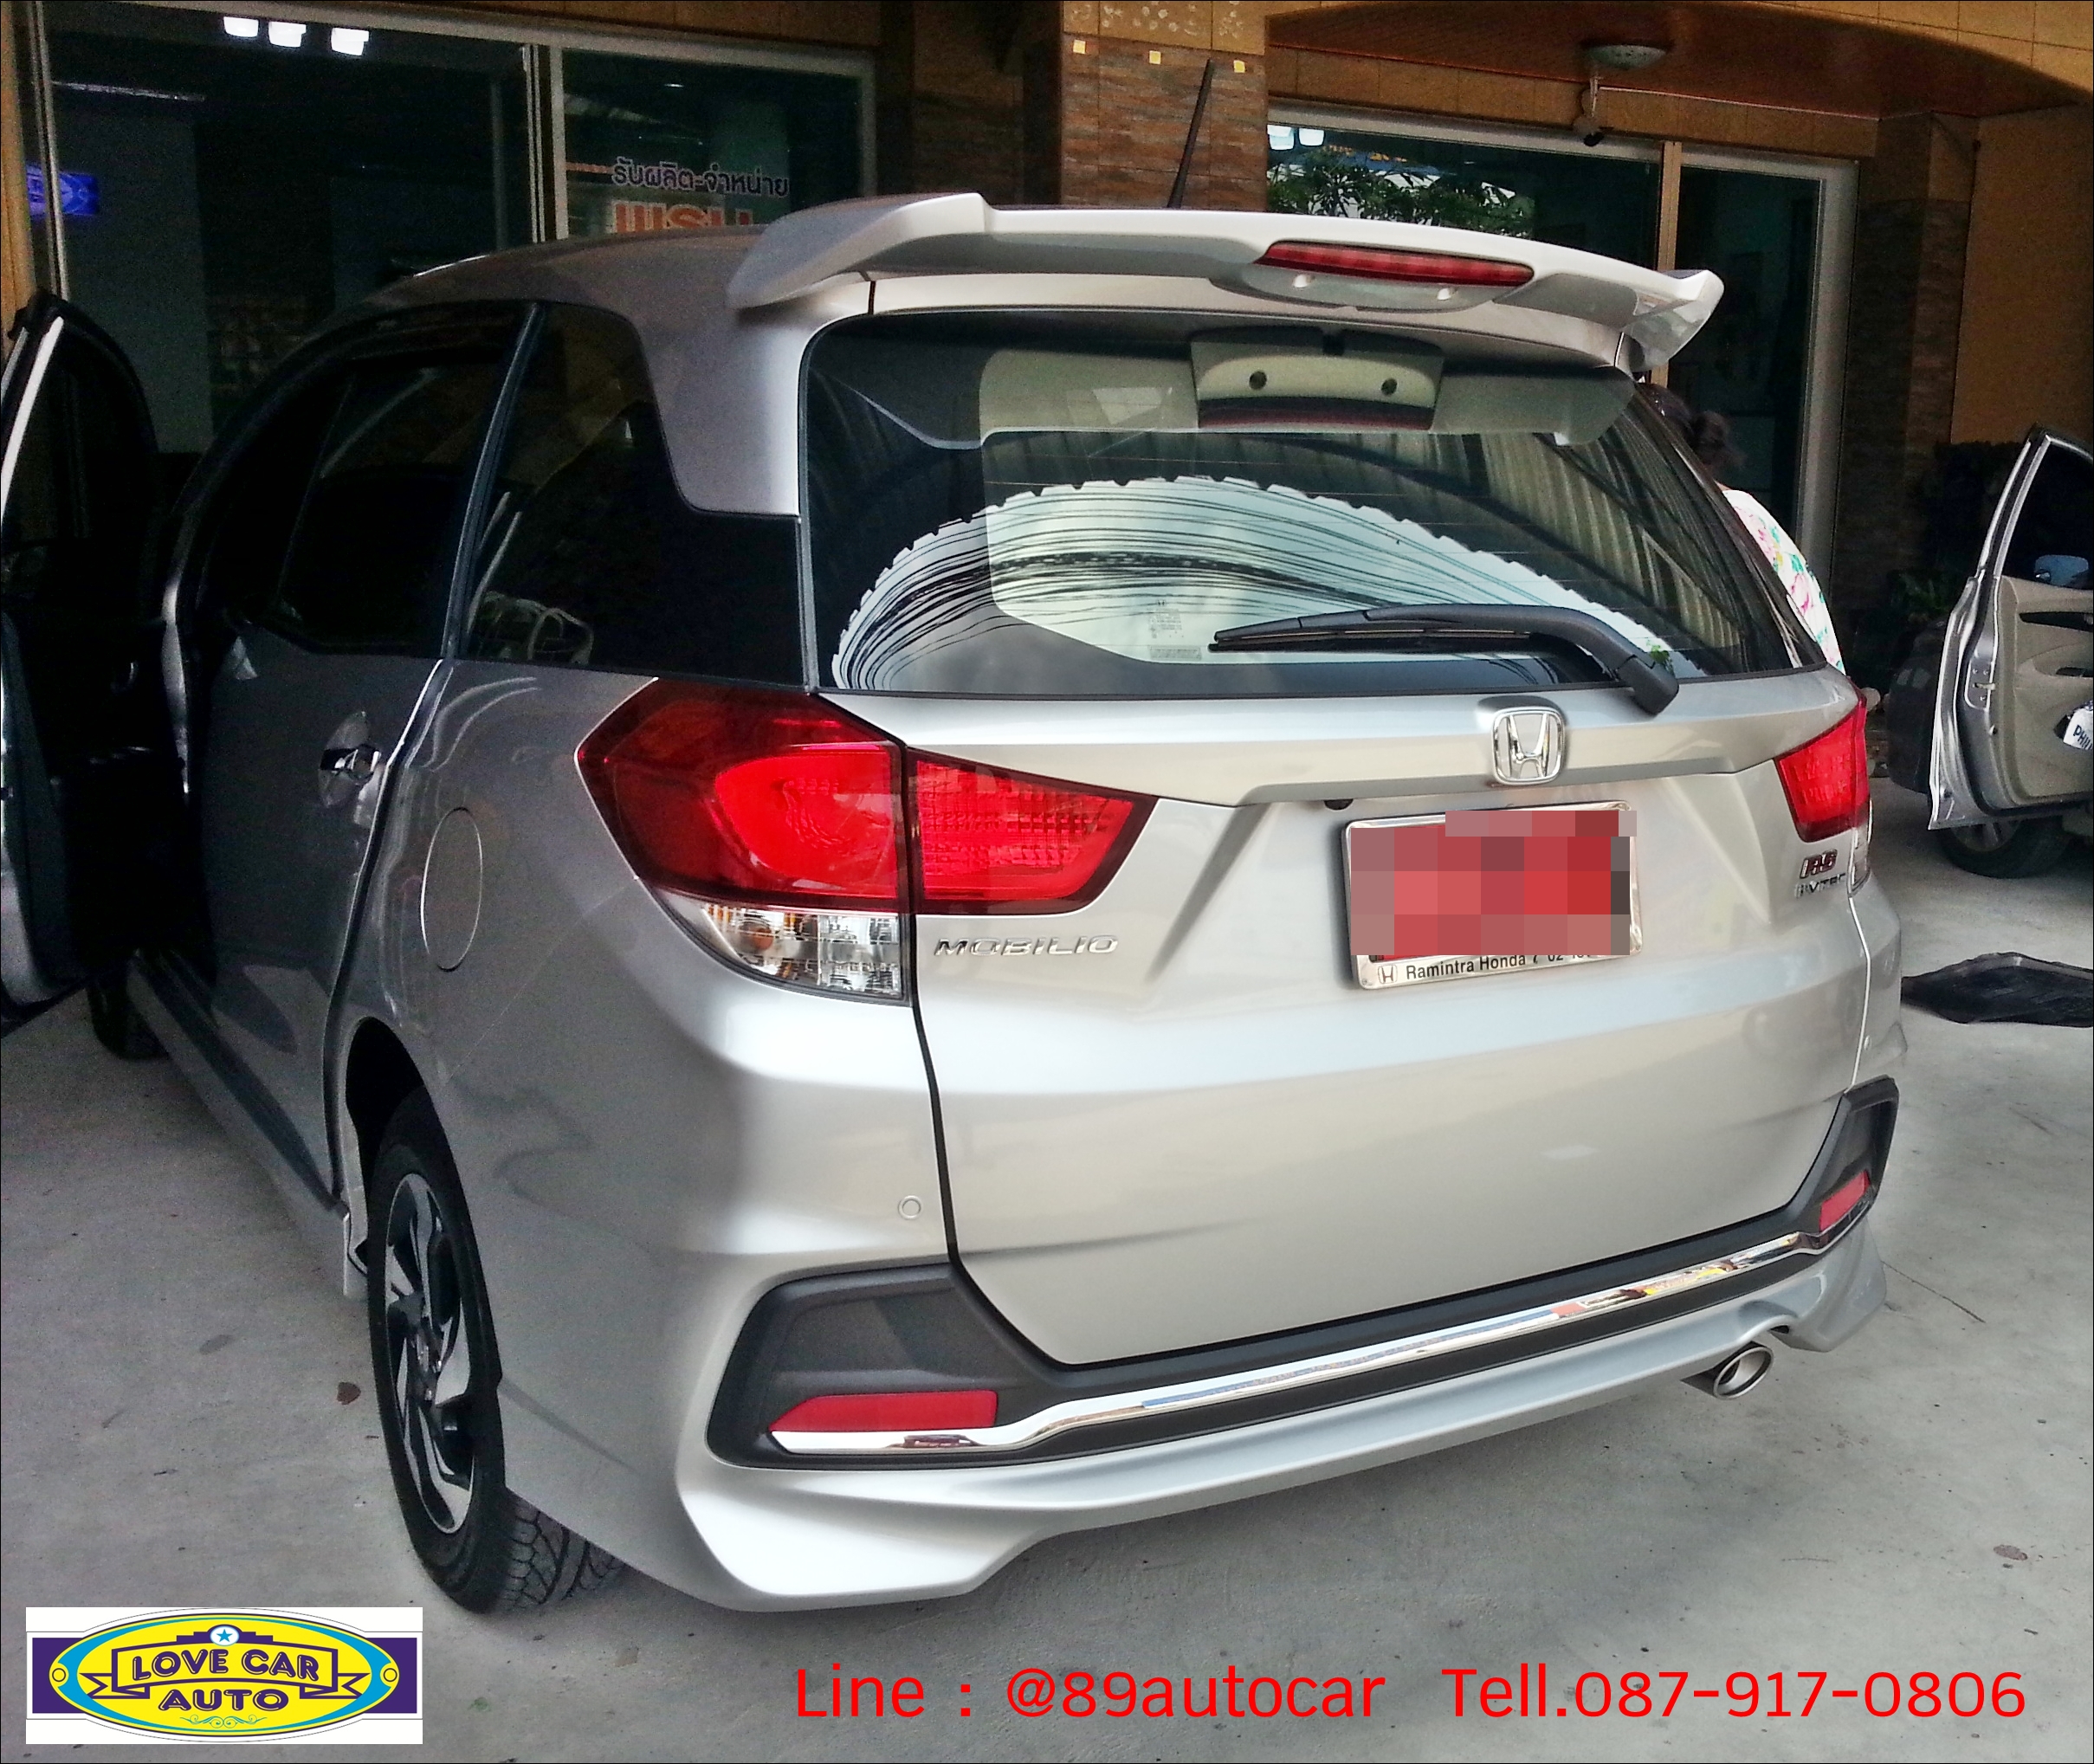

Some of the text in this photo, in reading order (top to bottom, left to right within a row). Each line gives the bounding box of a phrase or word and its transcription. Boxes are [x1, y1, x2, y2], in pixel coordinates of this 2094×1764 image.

[611, 155, 790, 197] รับผลิต-จำหน่าย
[934, 934, 1119, 956] MOBILIO
[1406, 960, 1475, 980] Ramintra
[1479, 954, 1527, 971] Honda
